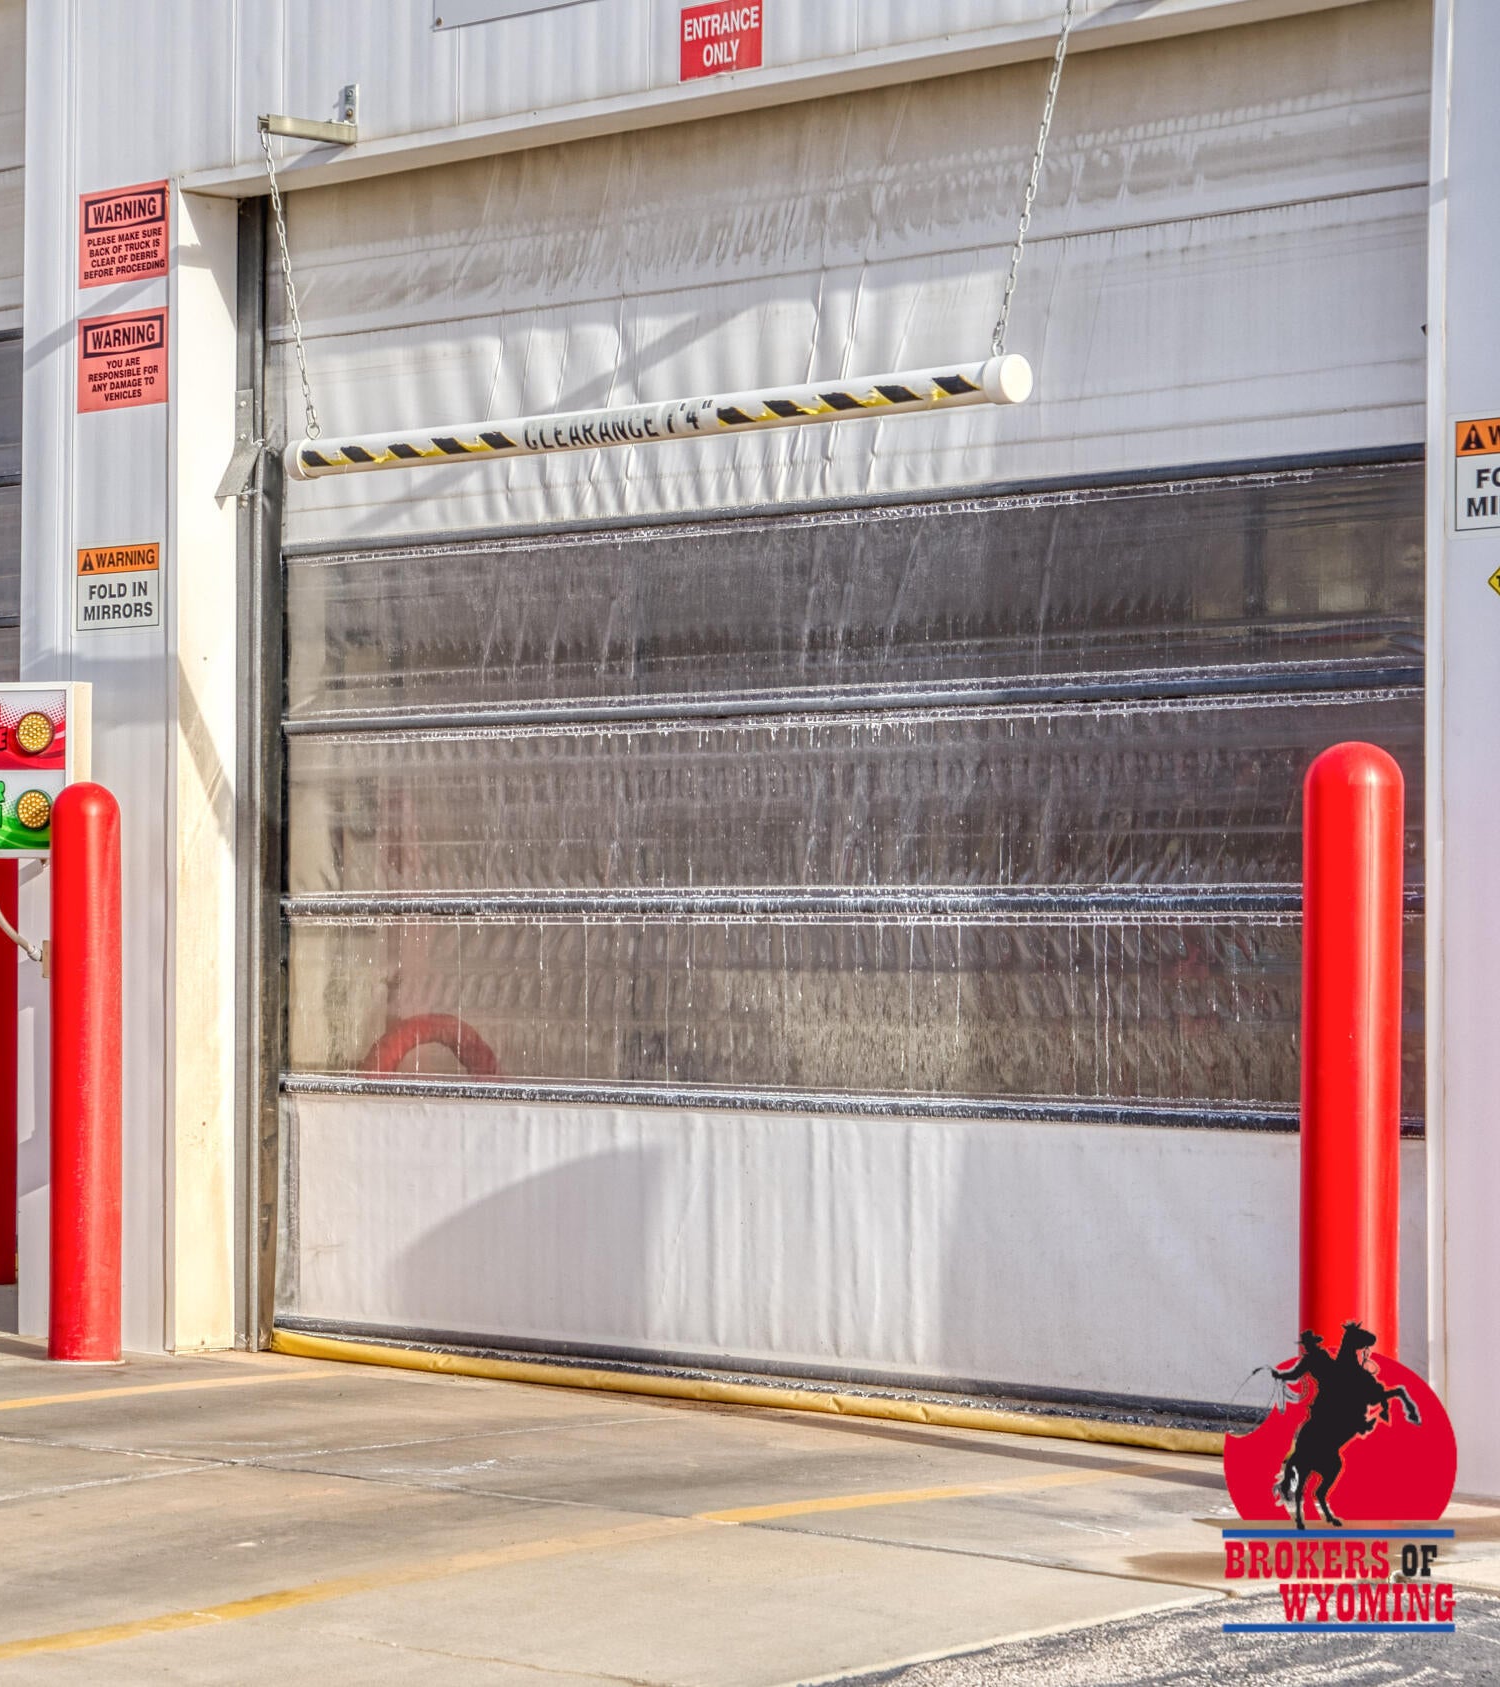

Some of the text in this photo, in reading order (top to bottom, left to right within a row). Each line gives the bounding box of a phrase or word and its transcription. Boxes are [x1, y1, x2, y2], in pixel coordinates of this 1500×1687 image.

[684, 6, 760, 42] ENTRANCE
[702, 39, 740, 67] ONLY
[93, 196, 157, 225] WARNING
[87, 227, 162, 247] PLEASE MAKE SURE
[89, 238, 160, 258] BACK OF TRUCK IS
[91, 249, 158, 268] CLEAR OF DEBRIS
[84, 259, 165, 280] BEFORE PROCEEDING
[92, 323, 155, 350] WARNING
[106, 357, 140, 369] YOU ARE
[88, 365, 158, 382] RESPONSIBLE FOR
[92, 376, 155, 392] ANY DAMAGE TO
[104, 389, 142, 401] VEHICLES
[96, 549, 155, 568] WARNING
[89, 581, 148, 600] FOLD IN
[84, 601, 153, 621] MIRRORS
